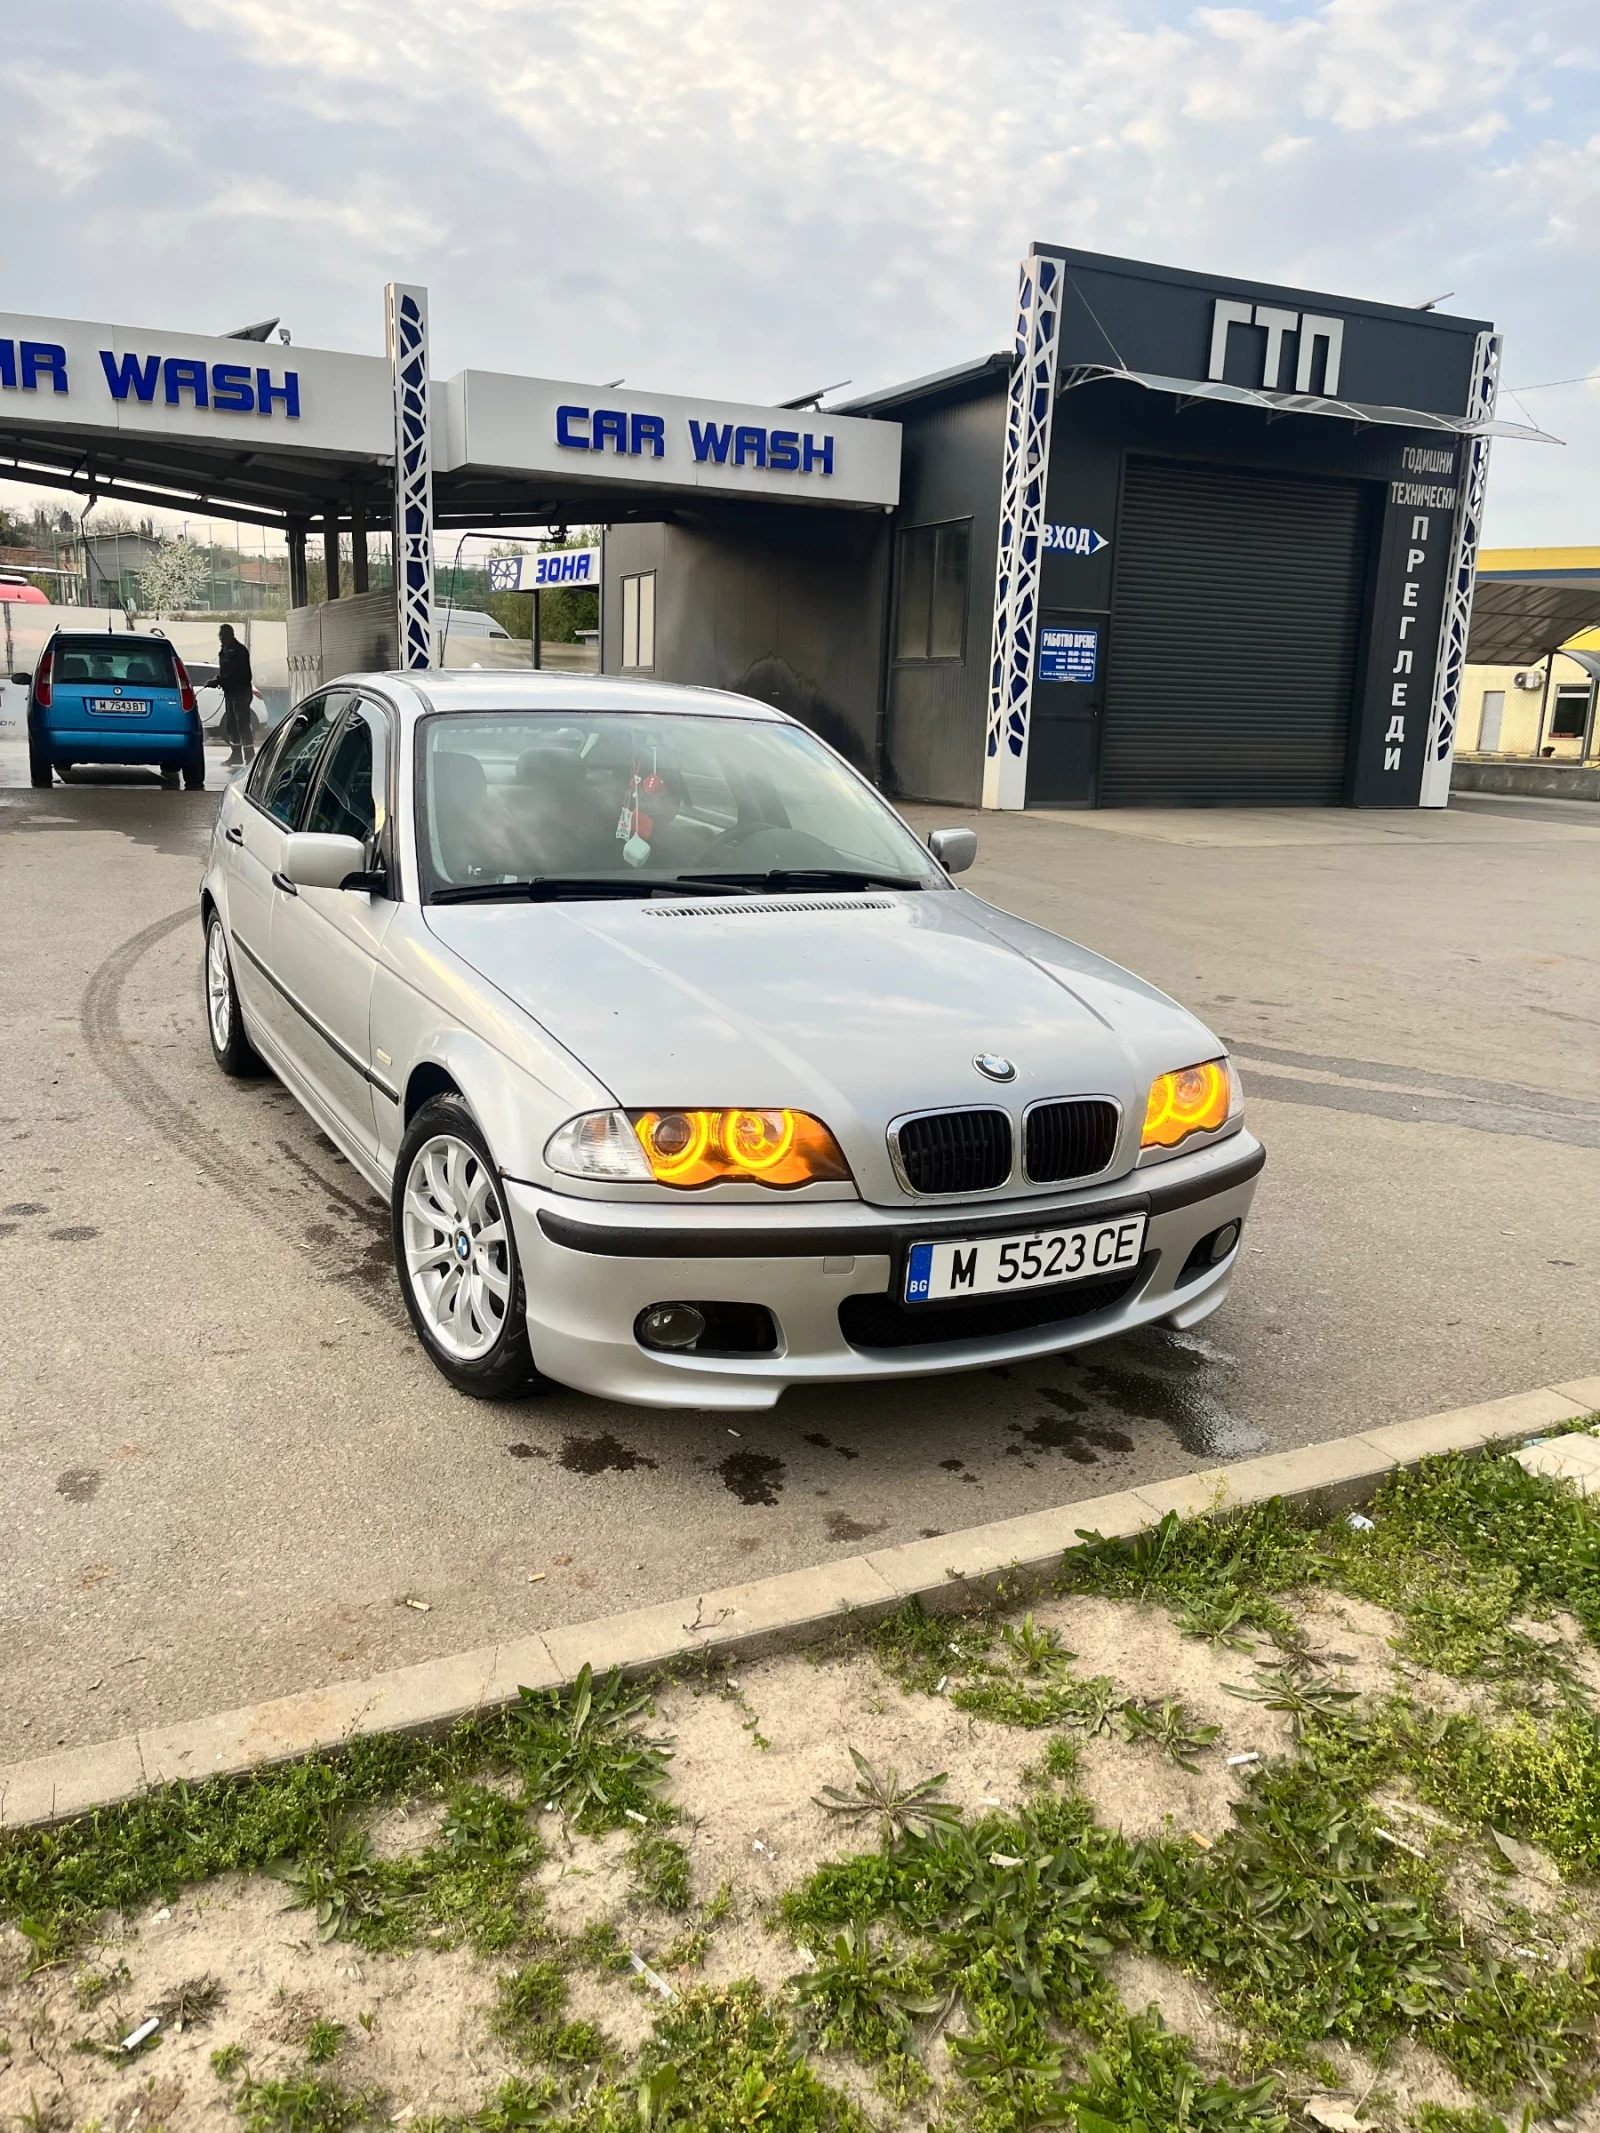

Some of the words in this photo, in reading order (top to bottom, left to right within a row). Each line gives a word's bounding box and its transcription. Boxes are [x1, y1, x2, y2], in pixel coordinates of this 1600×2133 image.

[1208, 298, 1344, 396] ГТП
[99, 350, 301, 419] WASH
[556, 405, 665, 458] CAR
[688, 420, 834, 475] WASH
[1401, 446, 1454, 475] ГОДИШНИ
[1391, 481, 1457, 510] ТЕХНИЧЕСКИ
[1042, 523, 1090, 555] ВХОД
[535, 553, 591, 584] ЗОНА
[99, 701, 106, 710] M
[950, 1248, 978, 1290] M
[909, 1279, 928, 1293] BG
